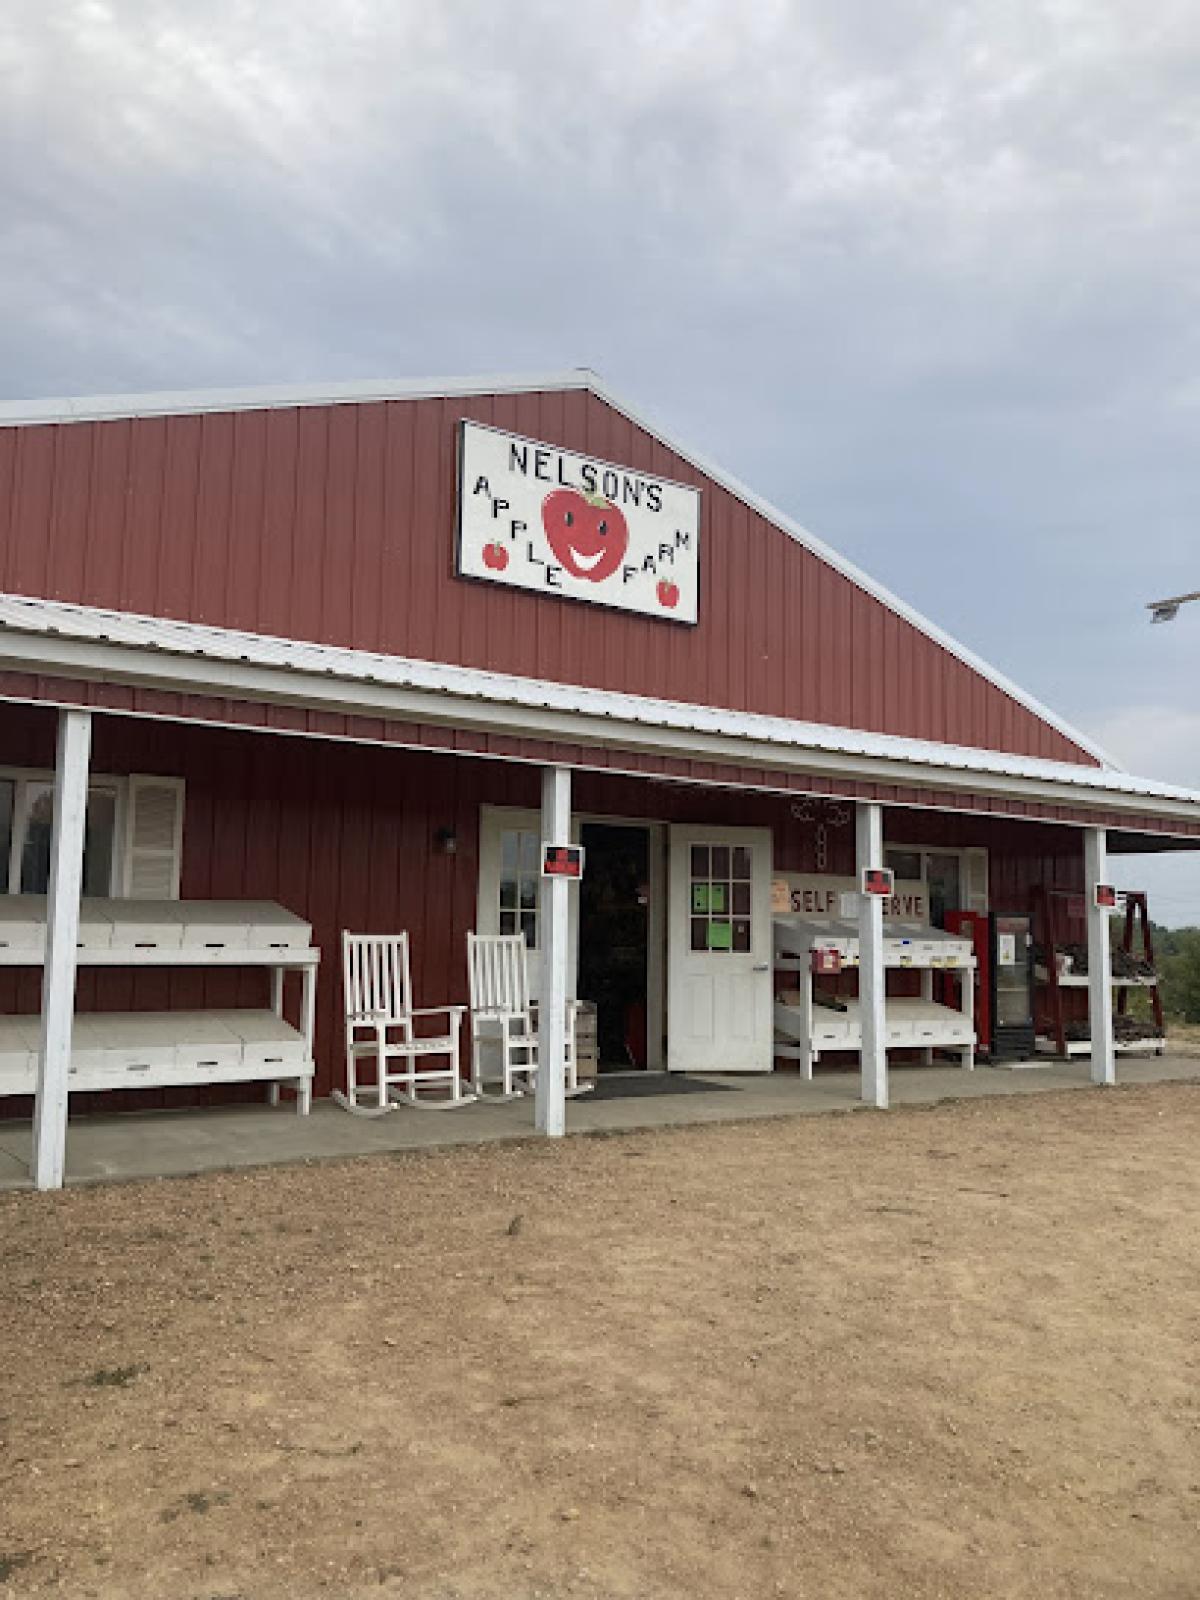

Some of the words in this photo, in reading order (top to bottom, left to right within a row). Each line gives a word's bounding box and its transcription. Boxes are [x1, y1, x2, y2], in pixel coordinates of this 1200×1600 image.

[509, 443, 663, 512] NELSON'S
[473, 475, 562, 588] APPLE
[623, 529, 690, 584] FARM
[791, 889, 836, 913] SELF
[882, 894, 924, 918] ERVE
